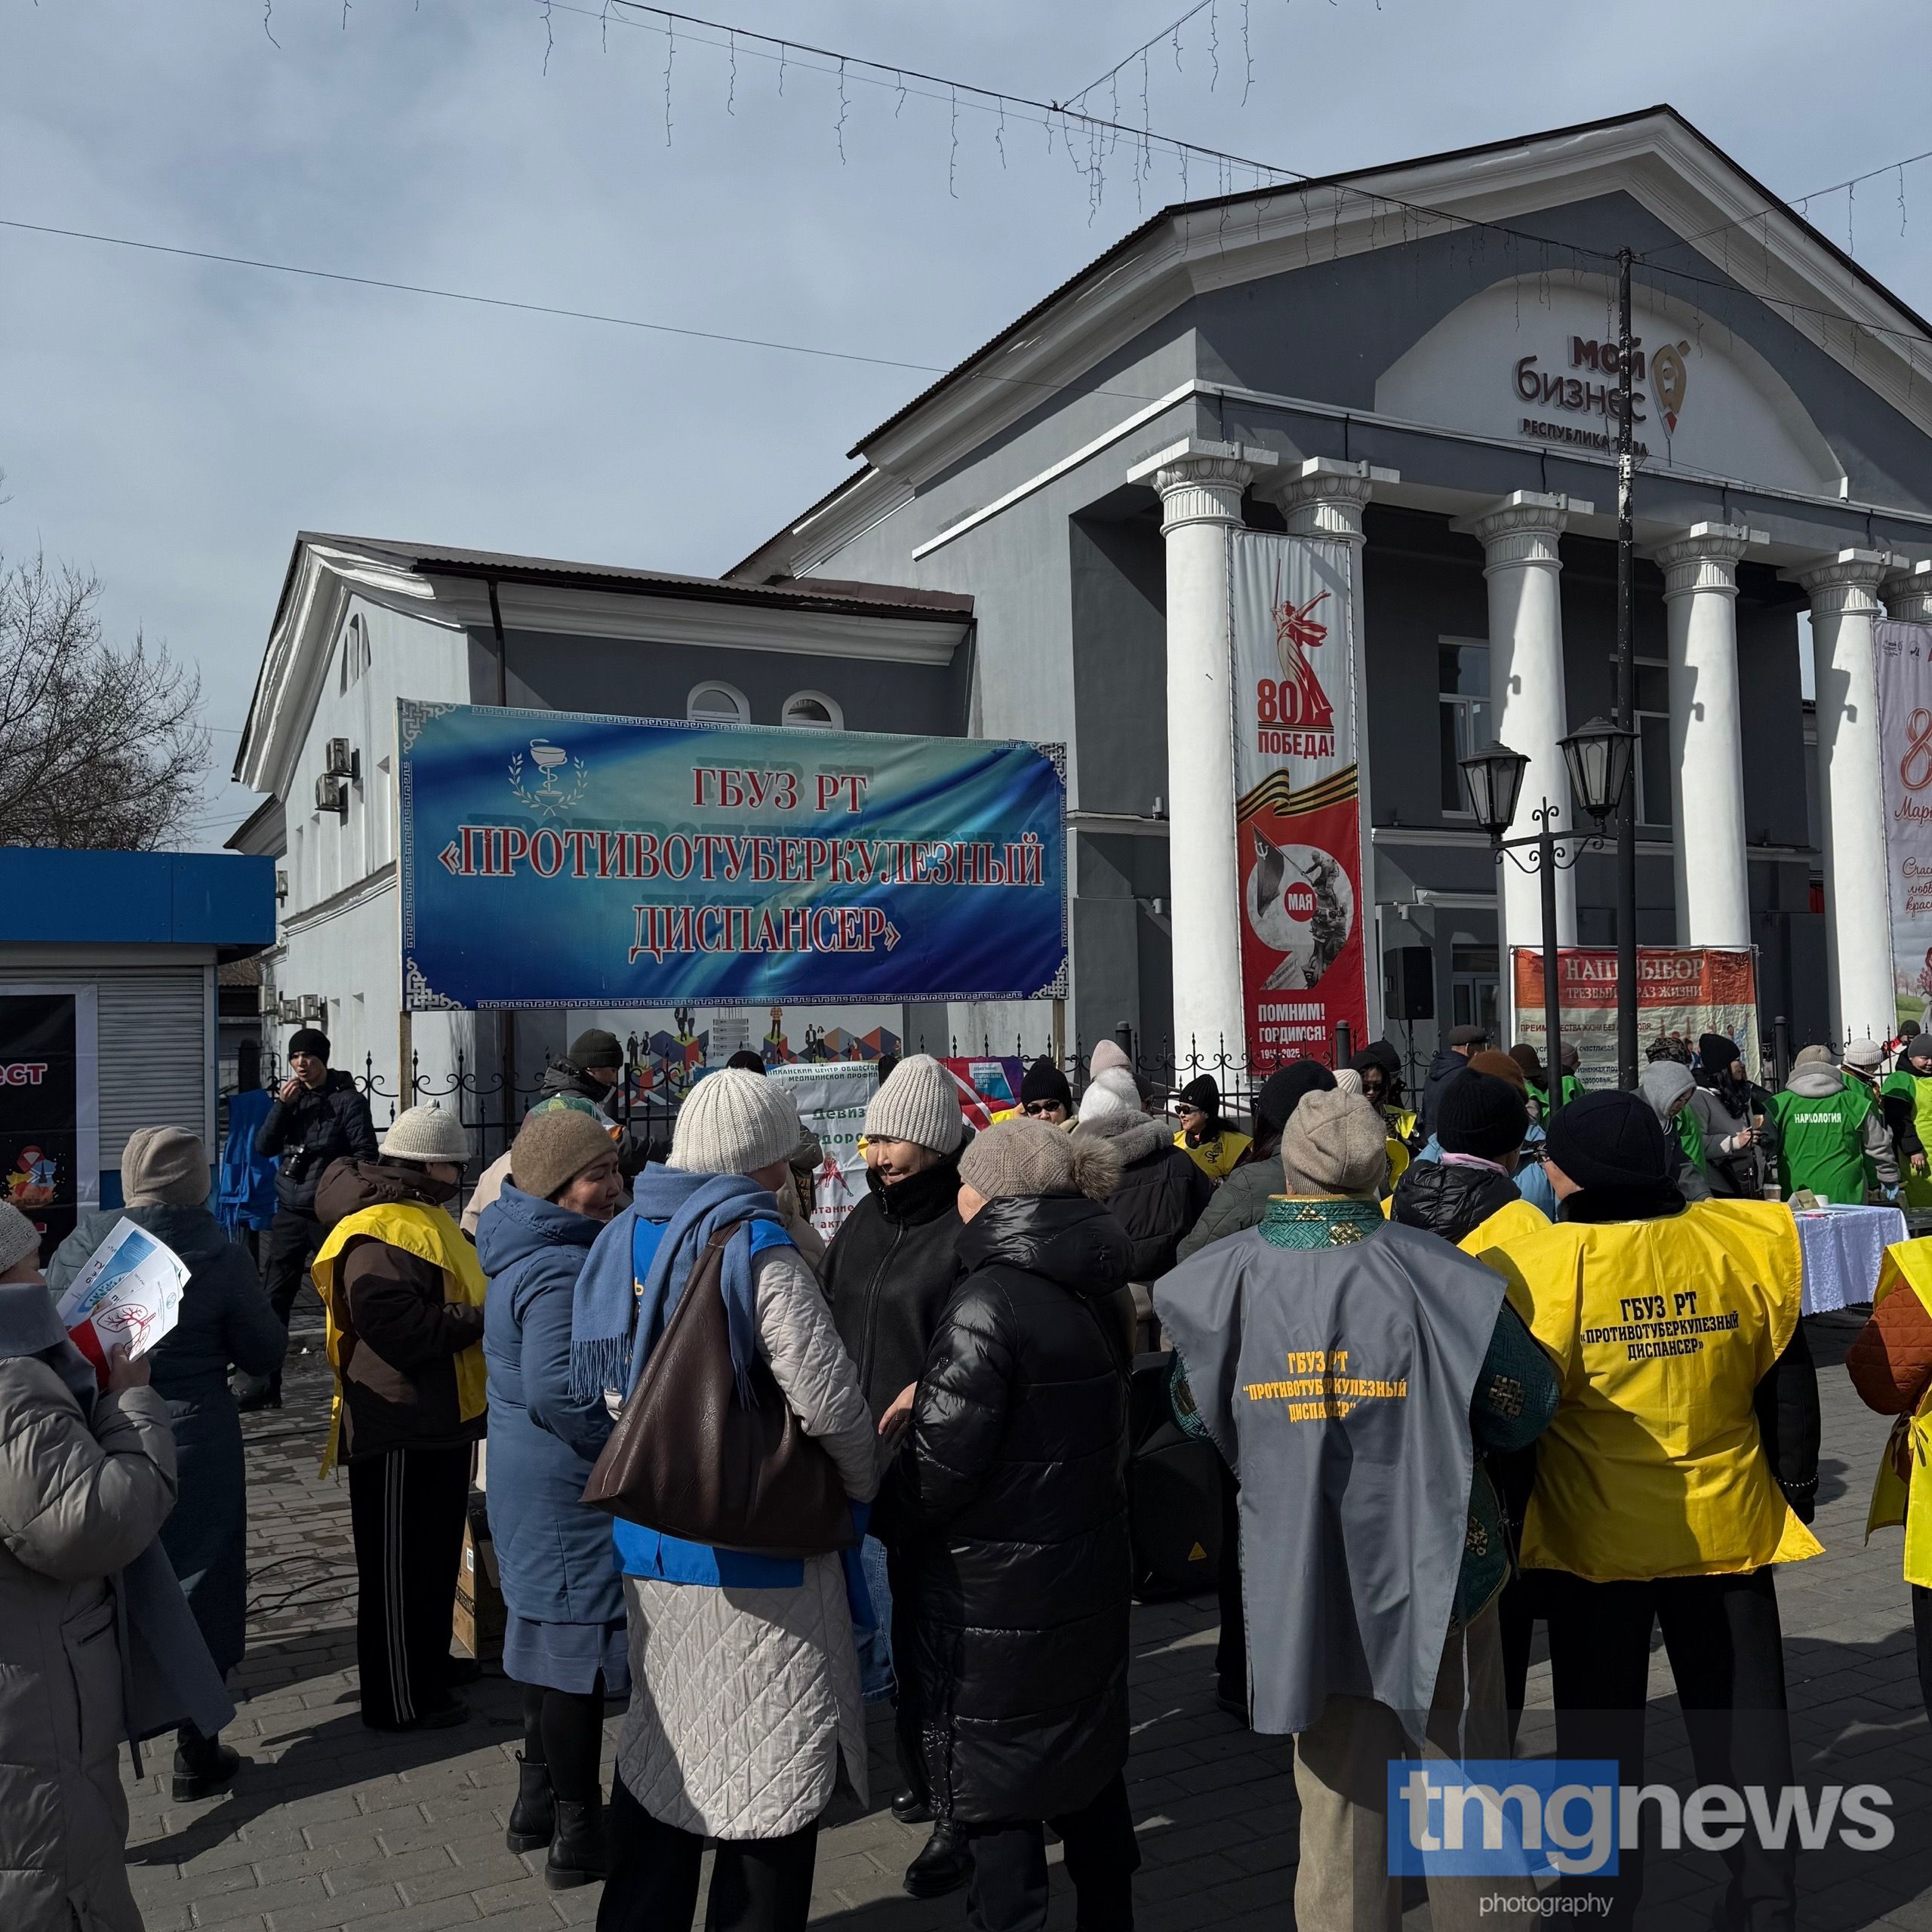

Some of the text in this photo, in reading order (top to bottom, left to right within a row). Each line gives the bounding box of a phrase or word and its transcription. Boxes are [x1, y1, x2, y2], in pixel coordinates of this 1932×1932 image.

[1521, 419, 1610, 449] РЕСПУБЛИКА
[1257, 678, 1297, 723] 80
[1257, 731, 1334, 759] ПОБЕДА!
[691, 767, 868, 813] ГБУЗ РТ
[437, 824, 1044, 888] «ПРОТИВОТУБЕРКУЛЕЗНЫЙ
[1287, 894, 1314, 912] МАЯ
[628, 904, 901, 964] ДИСПАНСЕР»
[1636, 958, 1704, 980] ЫБОР
[1661, 984, 1703, 998] ЖИЗНИ
[1258, 1003, 1326, 1022] ПОМНИМ!
[1259, 1026, 1327, 1044] ГОРДИМСЯ!
[1794, 1112, 1842, 1124] НАРКОЛОГИЯ
[1620, 1291, 1697, 1321] ГБУЗ РТ
[1580, 1310, 1740, 1343] «ПРОТИВОТУБЕРКУЛЕЗНЫЙ
[1287, 1350, 1326, 1374] ГБУЗ
[1628, 1338, 1703, 1361] ДИСПАНСЕР»
